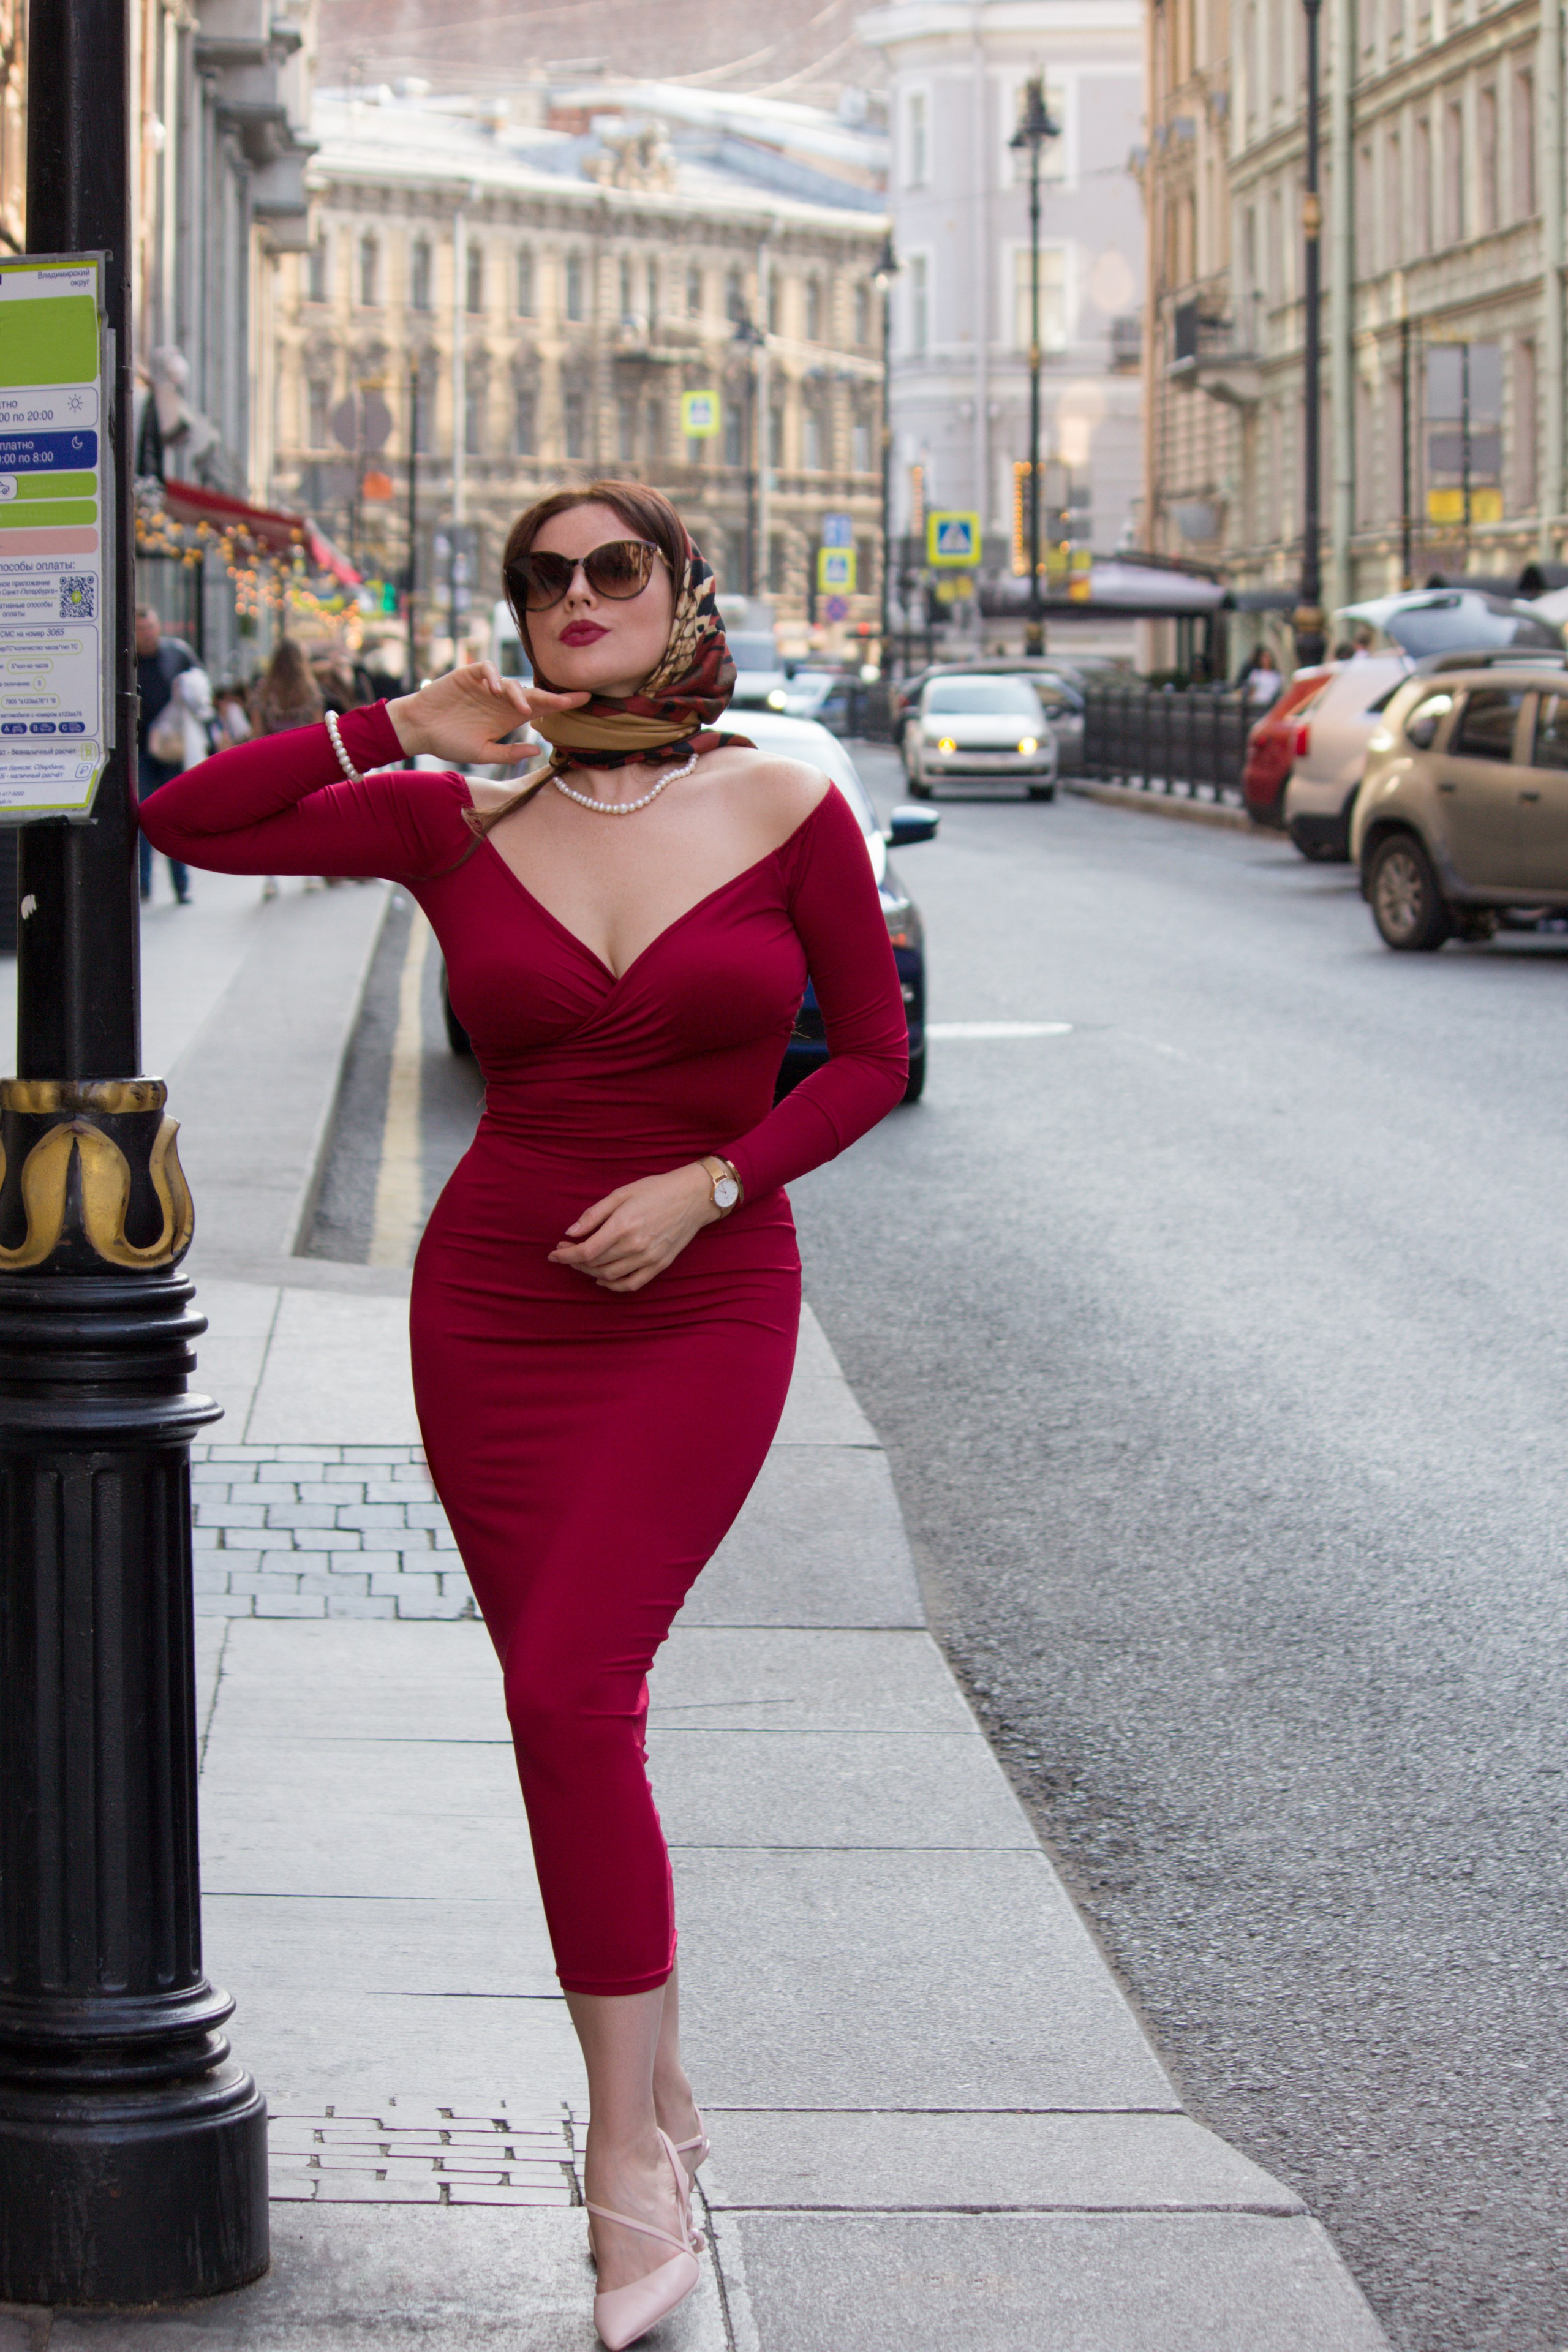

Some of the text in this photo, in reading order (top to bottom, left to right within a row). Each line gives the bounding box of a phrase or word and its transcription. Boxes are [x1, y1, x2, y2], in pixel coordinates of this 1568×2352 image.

[38, 269, 90, 279] Владимирский
[28, 410, 53, 420] 20:00
[0, 453, 15, 464] :00
[33, 451, 53, 462] 8:00
[36, 562, 75, 570] оплаты:
